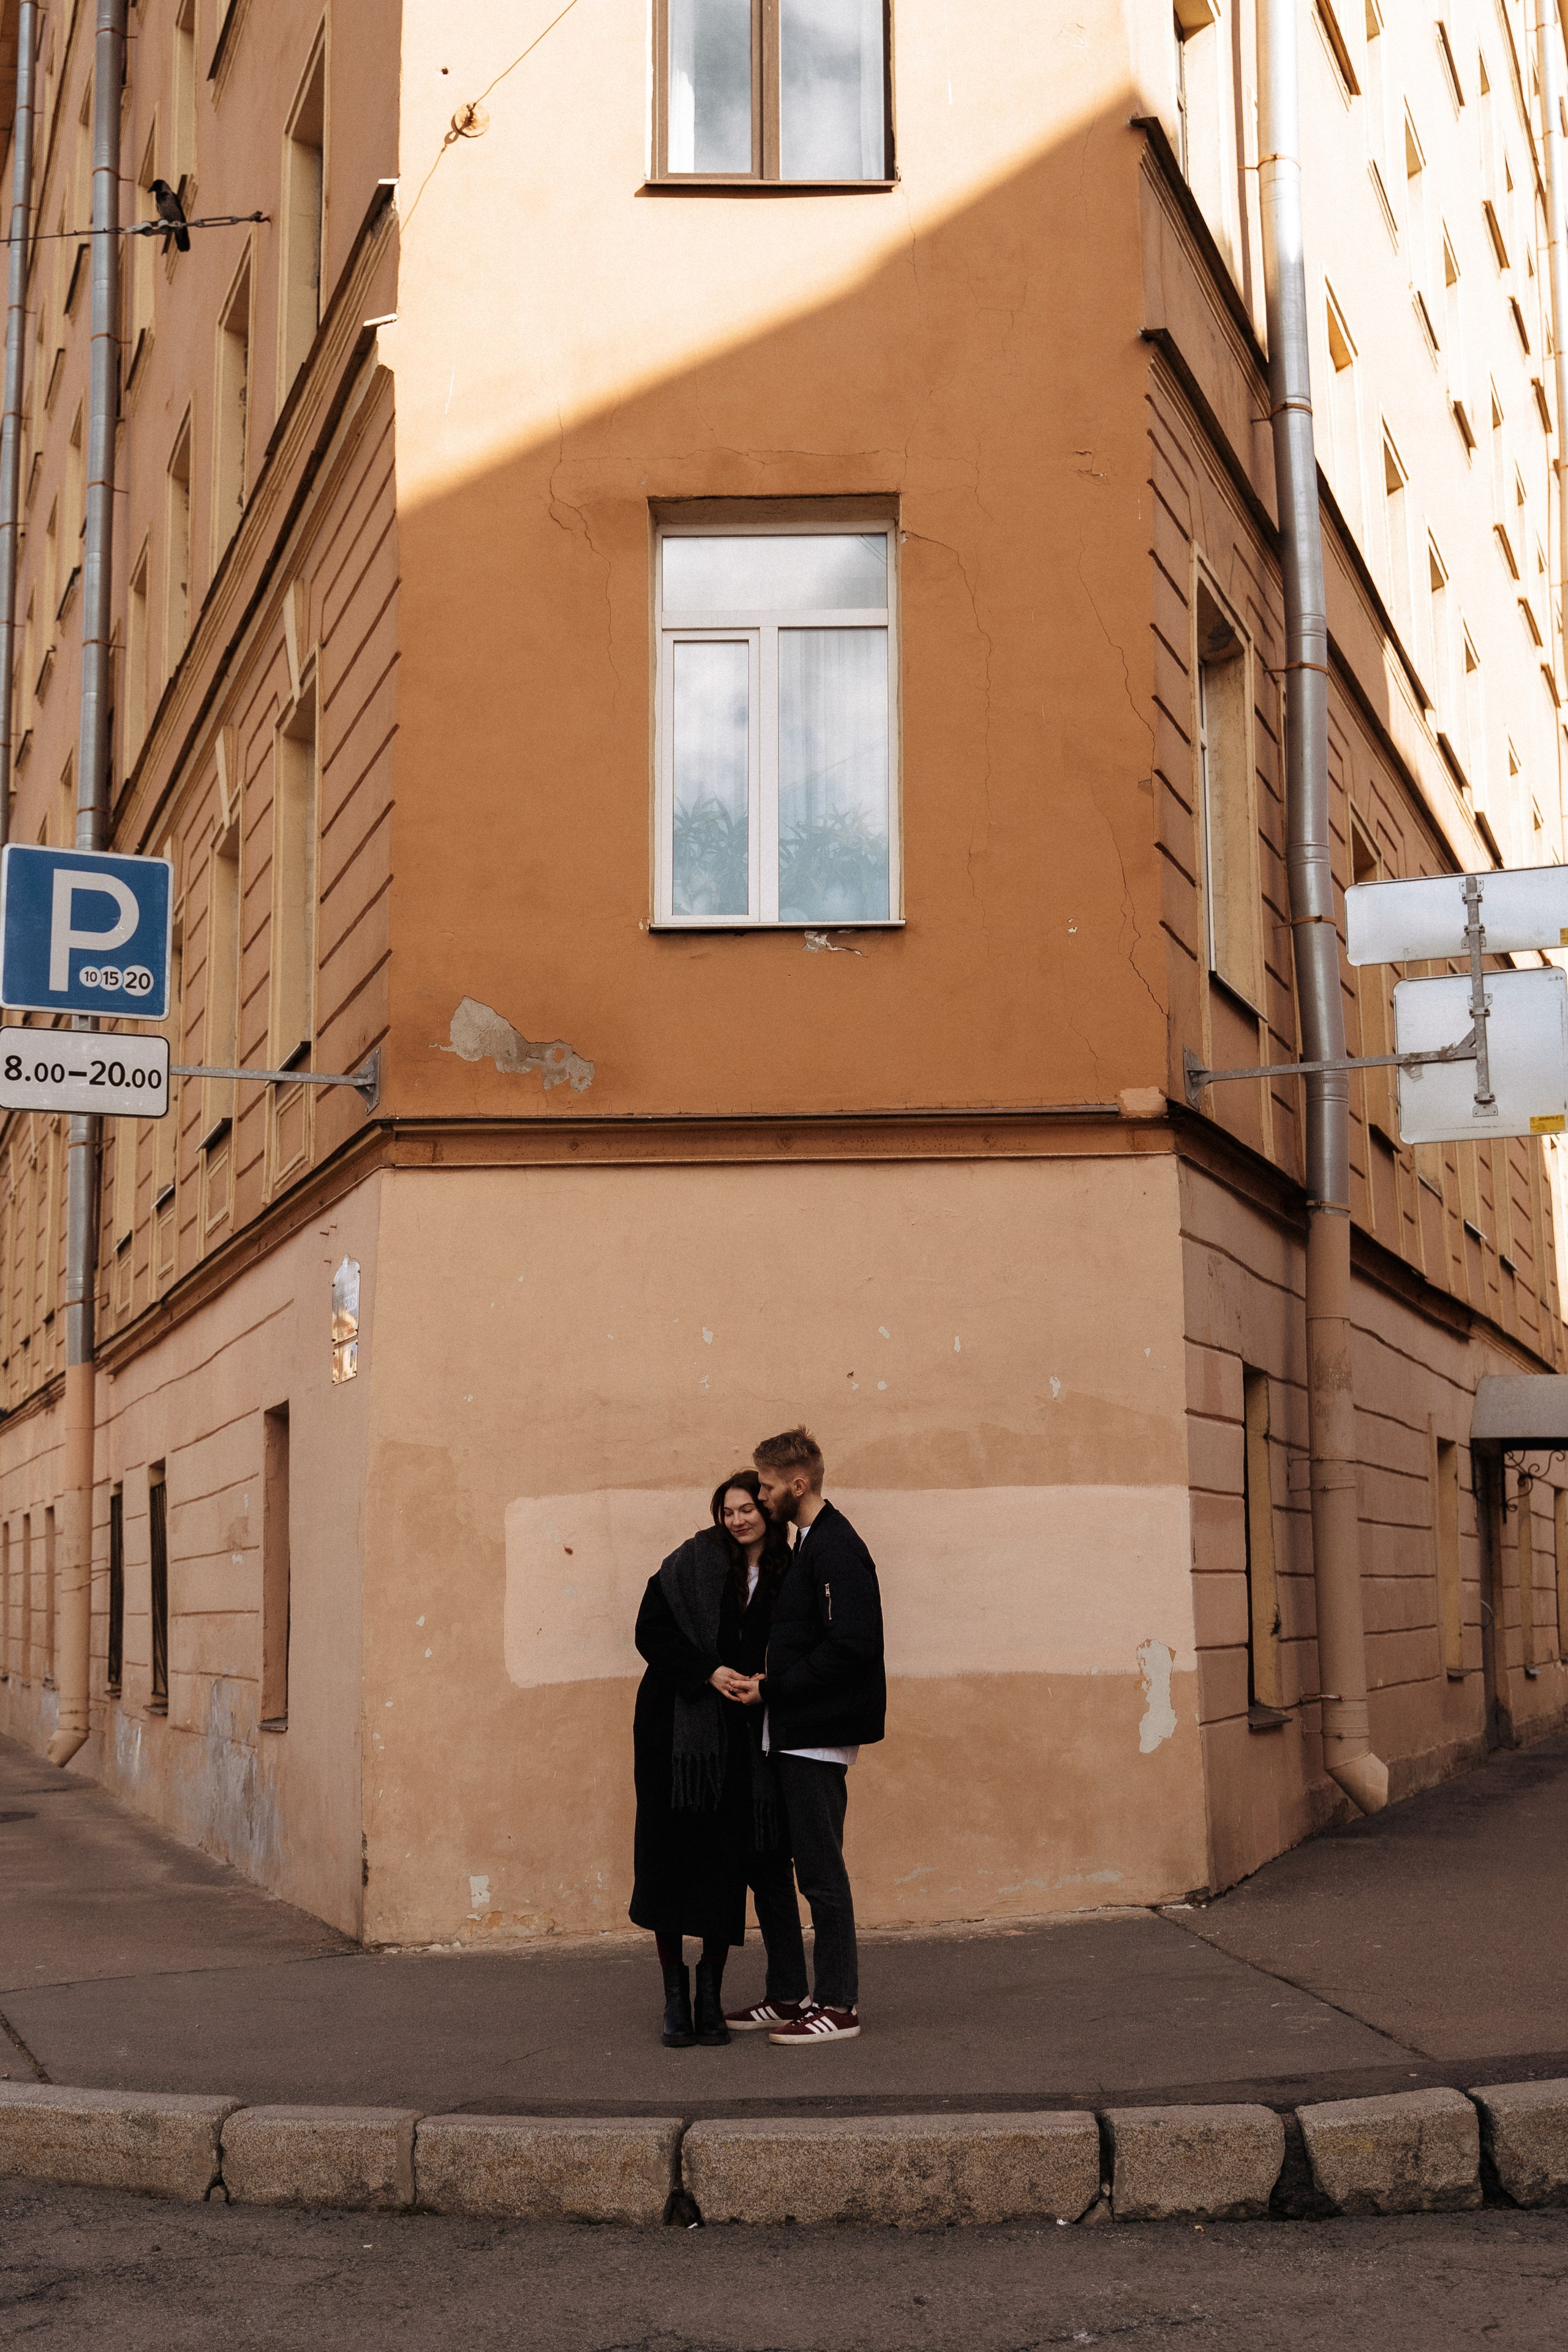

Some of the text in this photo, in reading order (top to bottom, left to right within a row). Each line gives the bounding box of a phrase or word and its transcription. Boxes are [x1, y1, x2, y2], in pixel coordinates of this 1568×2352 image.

[49, 869, 139, 992] P
[85, 971, 151, 990] 10 15 20
